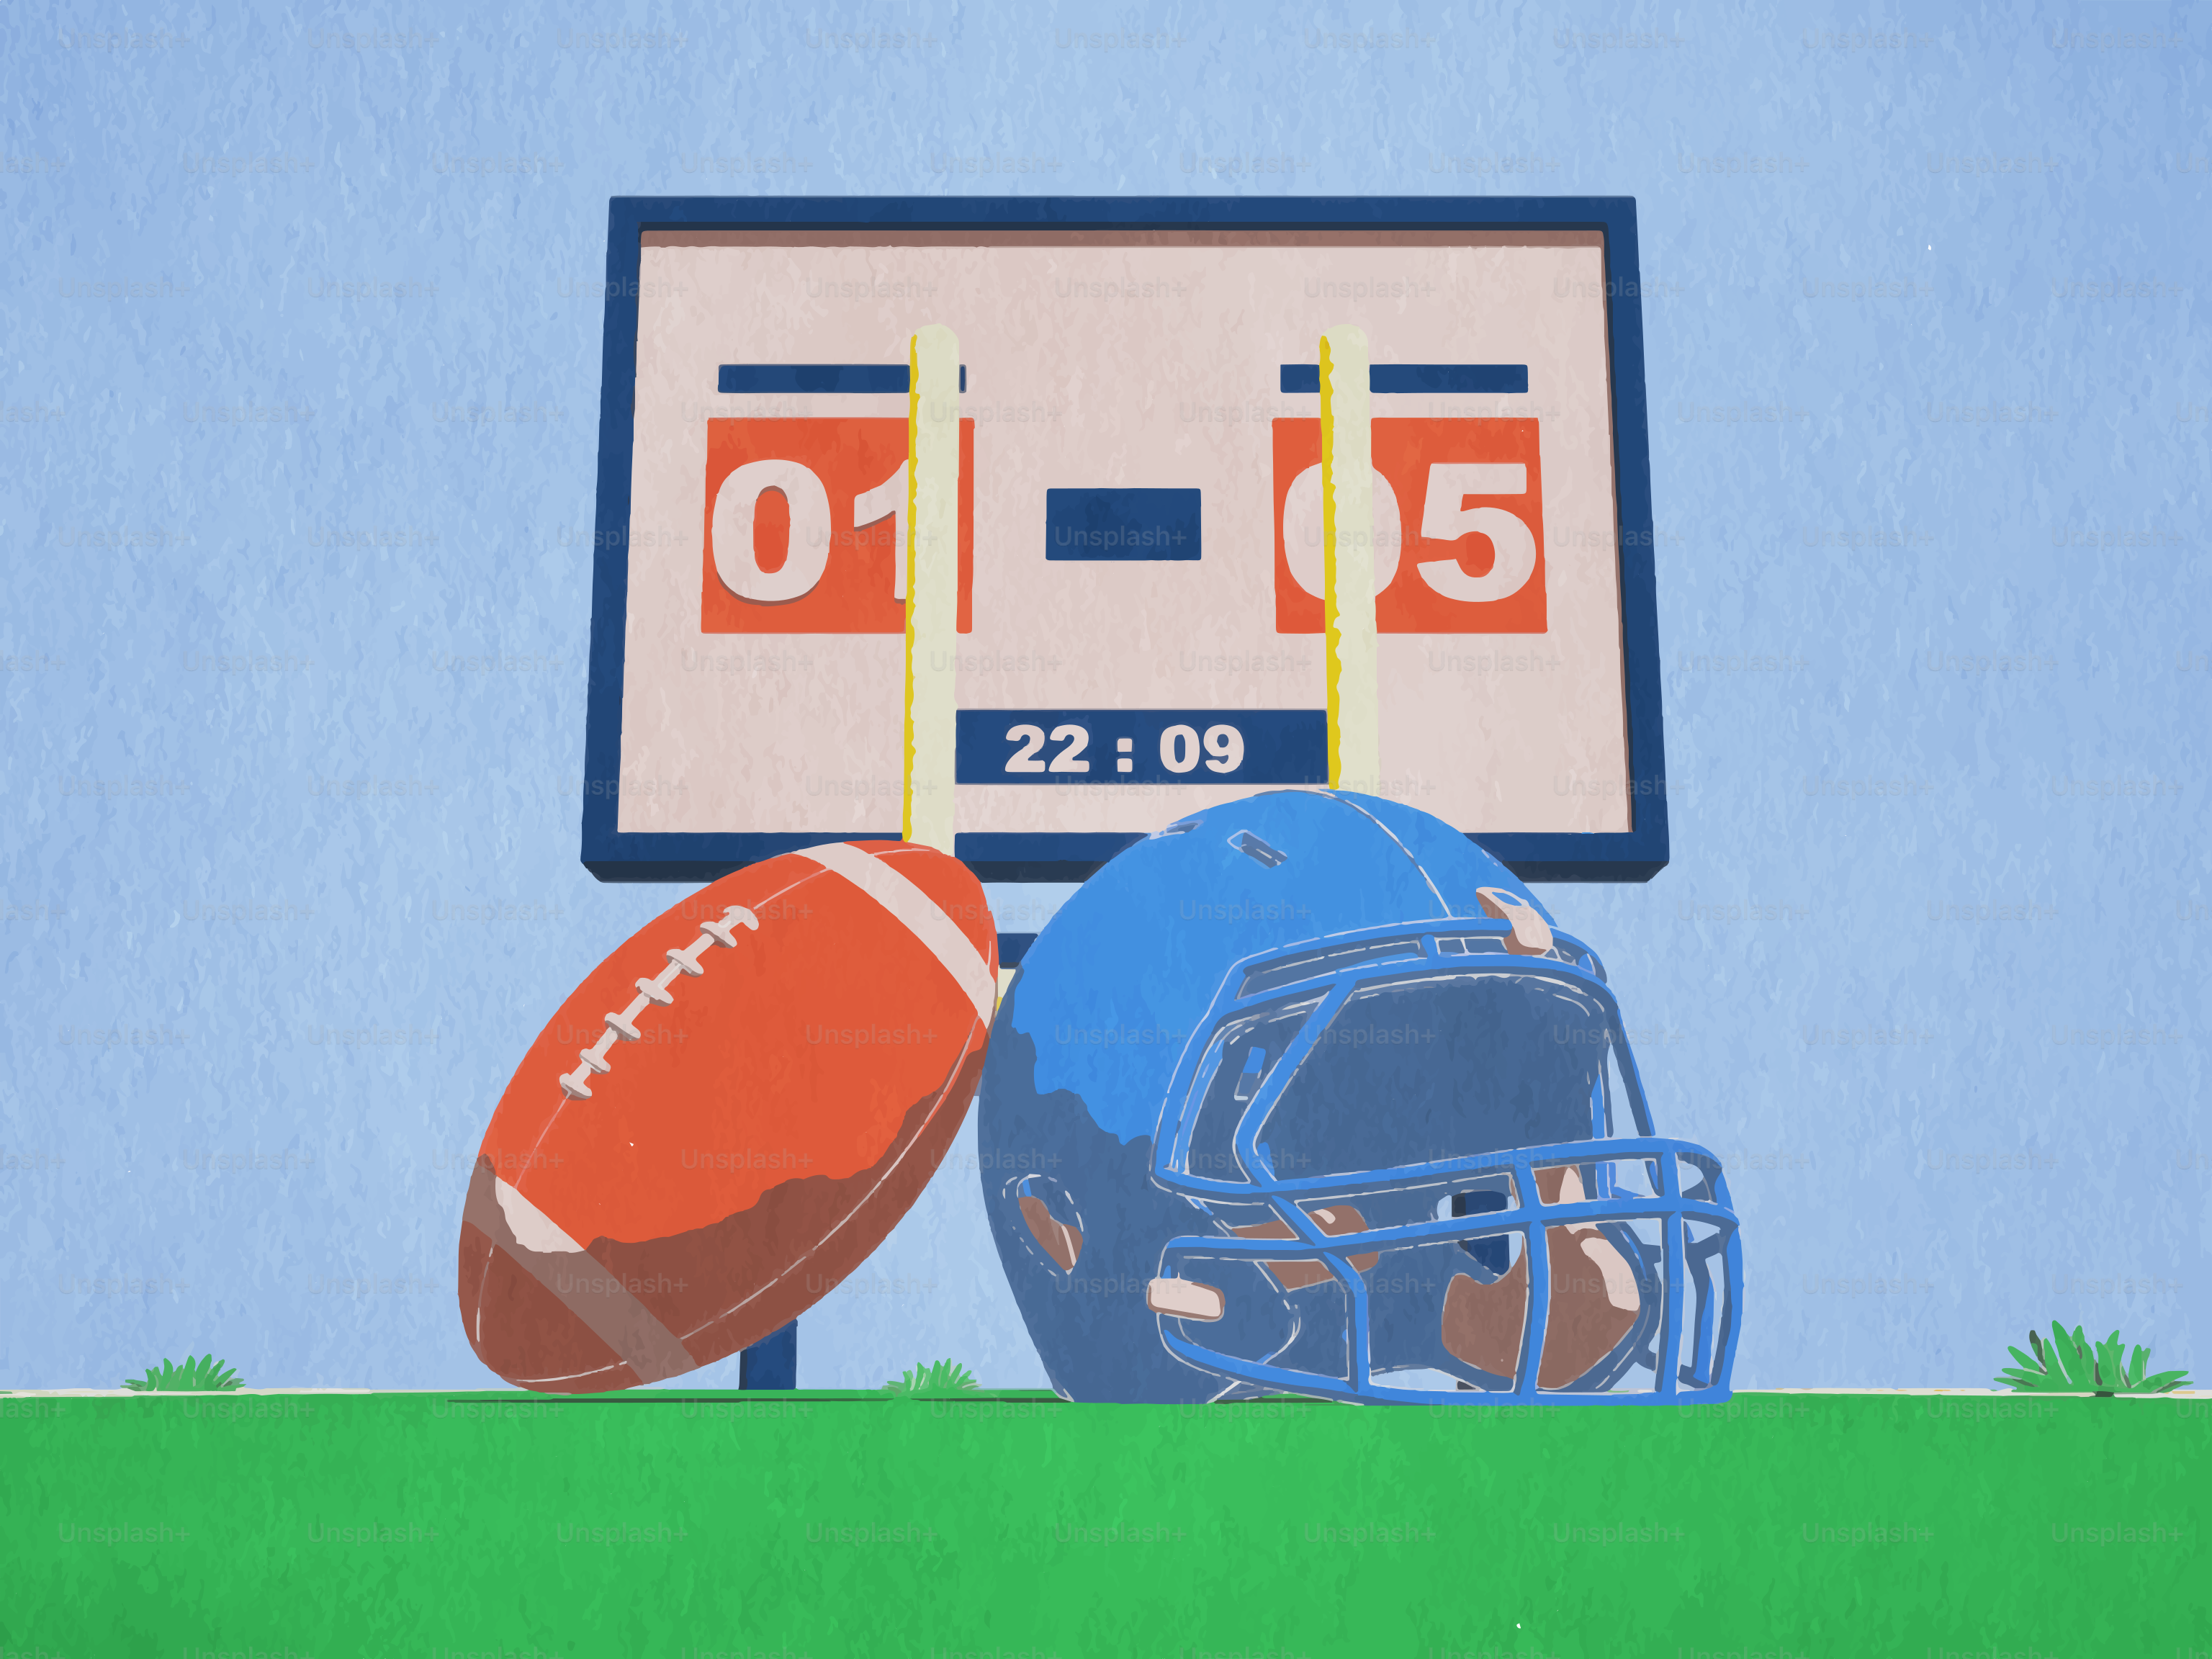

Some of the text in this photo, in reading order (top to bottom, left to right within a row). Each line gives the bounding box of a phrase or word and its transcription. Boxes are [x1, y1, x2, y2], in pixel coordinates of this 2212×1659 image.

[1283, 462, 1537, 603] 05
[1004, 724, 1244, 773] 22 : 09
